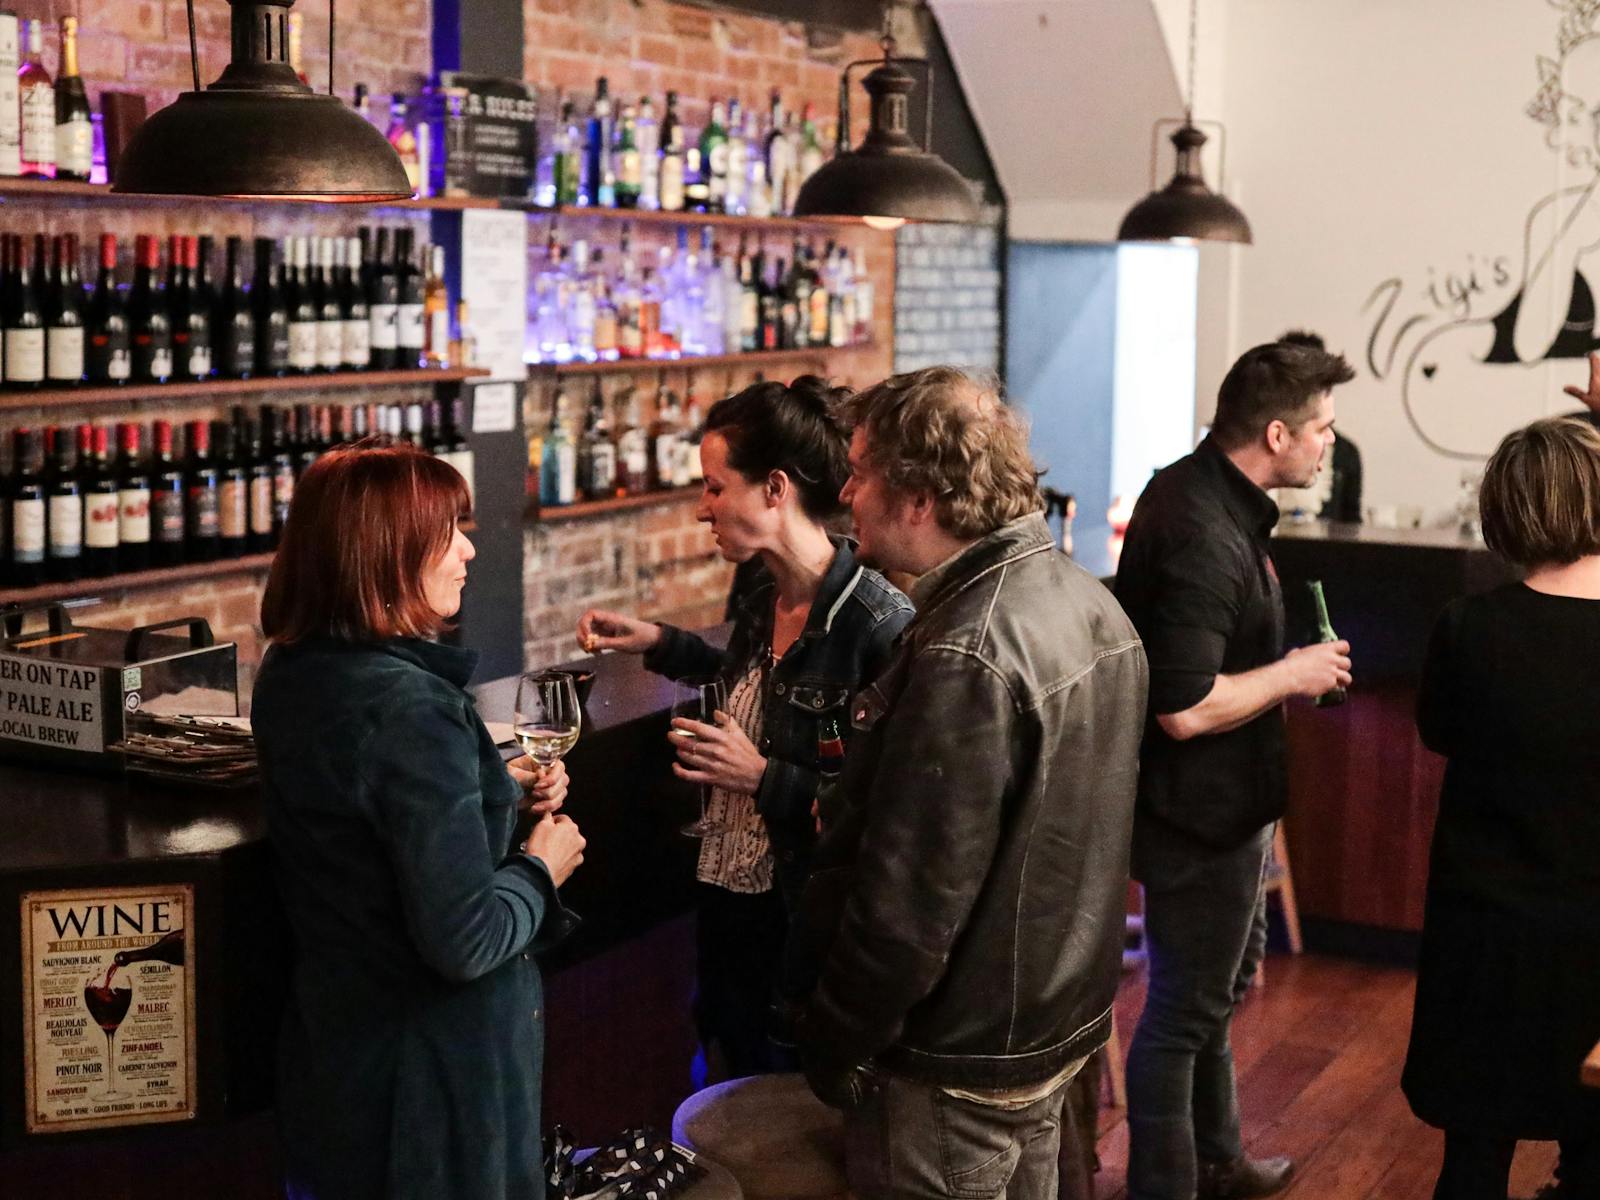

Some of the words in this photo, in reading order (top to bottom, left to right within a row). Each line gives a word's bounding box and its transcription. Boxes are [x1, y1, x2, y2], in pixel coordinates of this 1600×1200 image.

[27, 663, 51, 685] ON
[56, 668, 96, 690] TAP
[7, 691, 51, 717] PALE
[56, 699, 93, 722] ALE
[0, 719, 35, 739] OCAL
[38, 726, 79, 745] BREW
[47, 902, 171, 940] WINE
[56, 941, 77, 951] FROM
[81, 939, 112, 950] AROUND
[115, 937, 130, 947] THE
[42, 957, 79, 967] SAUVIGNON
[81, 955, 102, 965] BLANC
[43, 996, 78, 1009] MERLOT
[137, 1002, 170, 1014] MALBEC
[46, 1018, 87, 1030] BEAUJOLAIS
[50, 1028, 83, 1038] NOUVEAU
[61, 1046, 99, 1057] RIESLING
[121, 1042, 164, 1053] ZINFANDEL
[56, 1064, 79, 1076] PINOT
[82, 1062, 103, 1074] NOIR
[118, 1063, 145, 1073] CABERNET
[146, 1079, 169, 1088] SYRAH
[56, 1108, 72, 1117] GOOD
[74, 1106, 89, 1116] WINE
[93, 1104, 110, 1113] GOOD
[139, 1101, 155, 1110] LONG
[156, 1100, 168, 1108] LIFE
